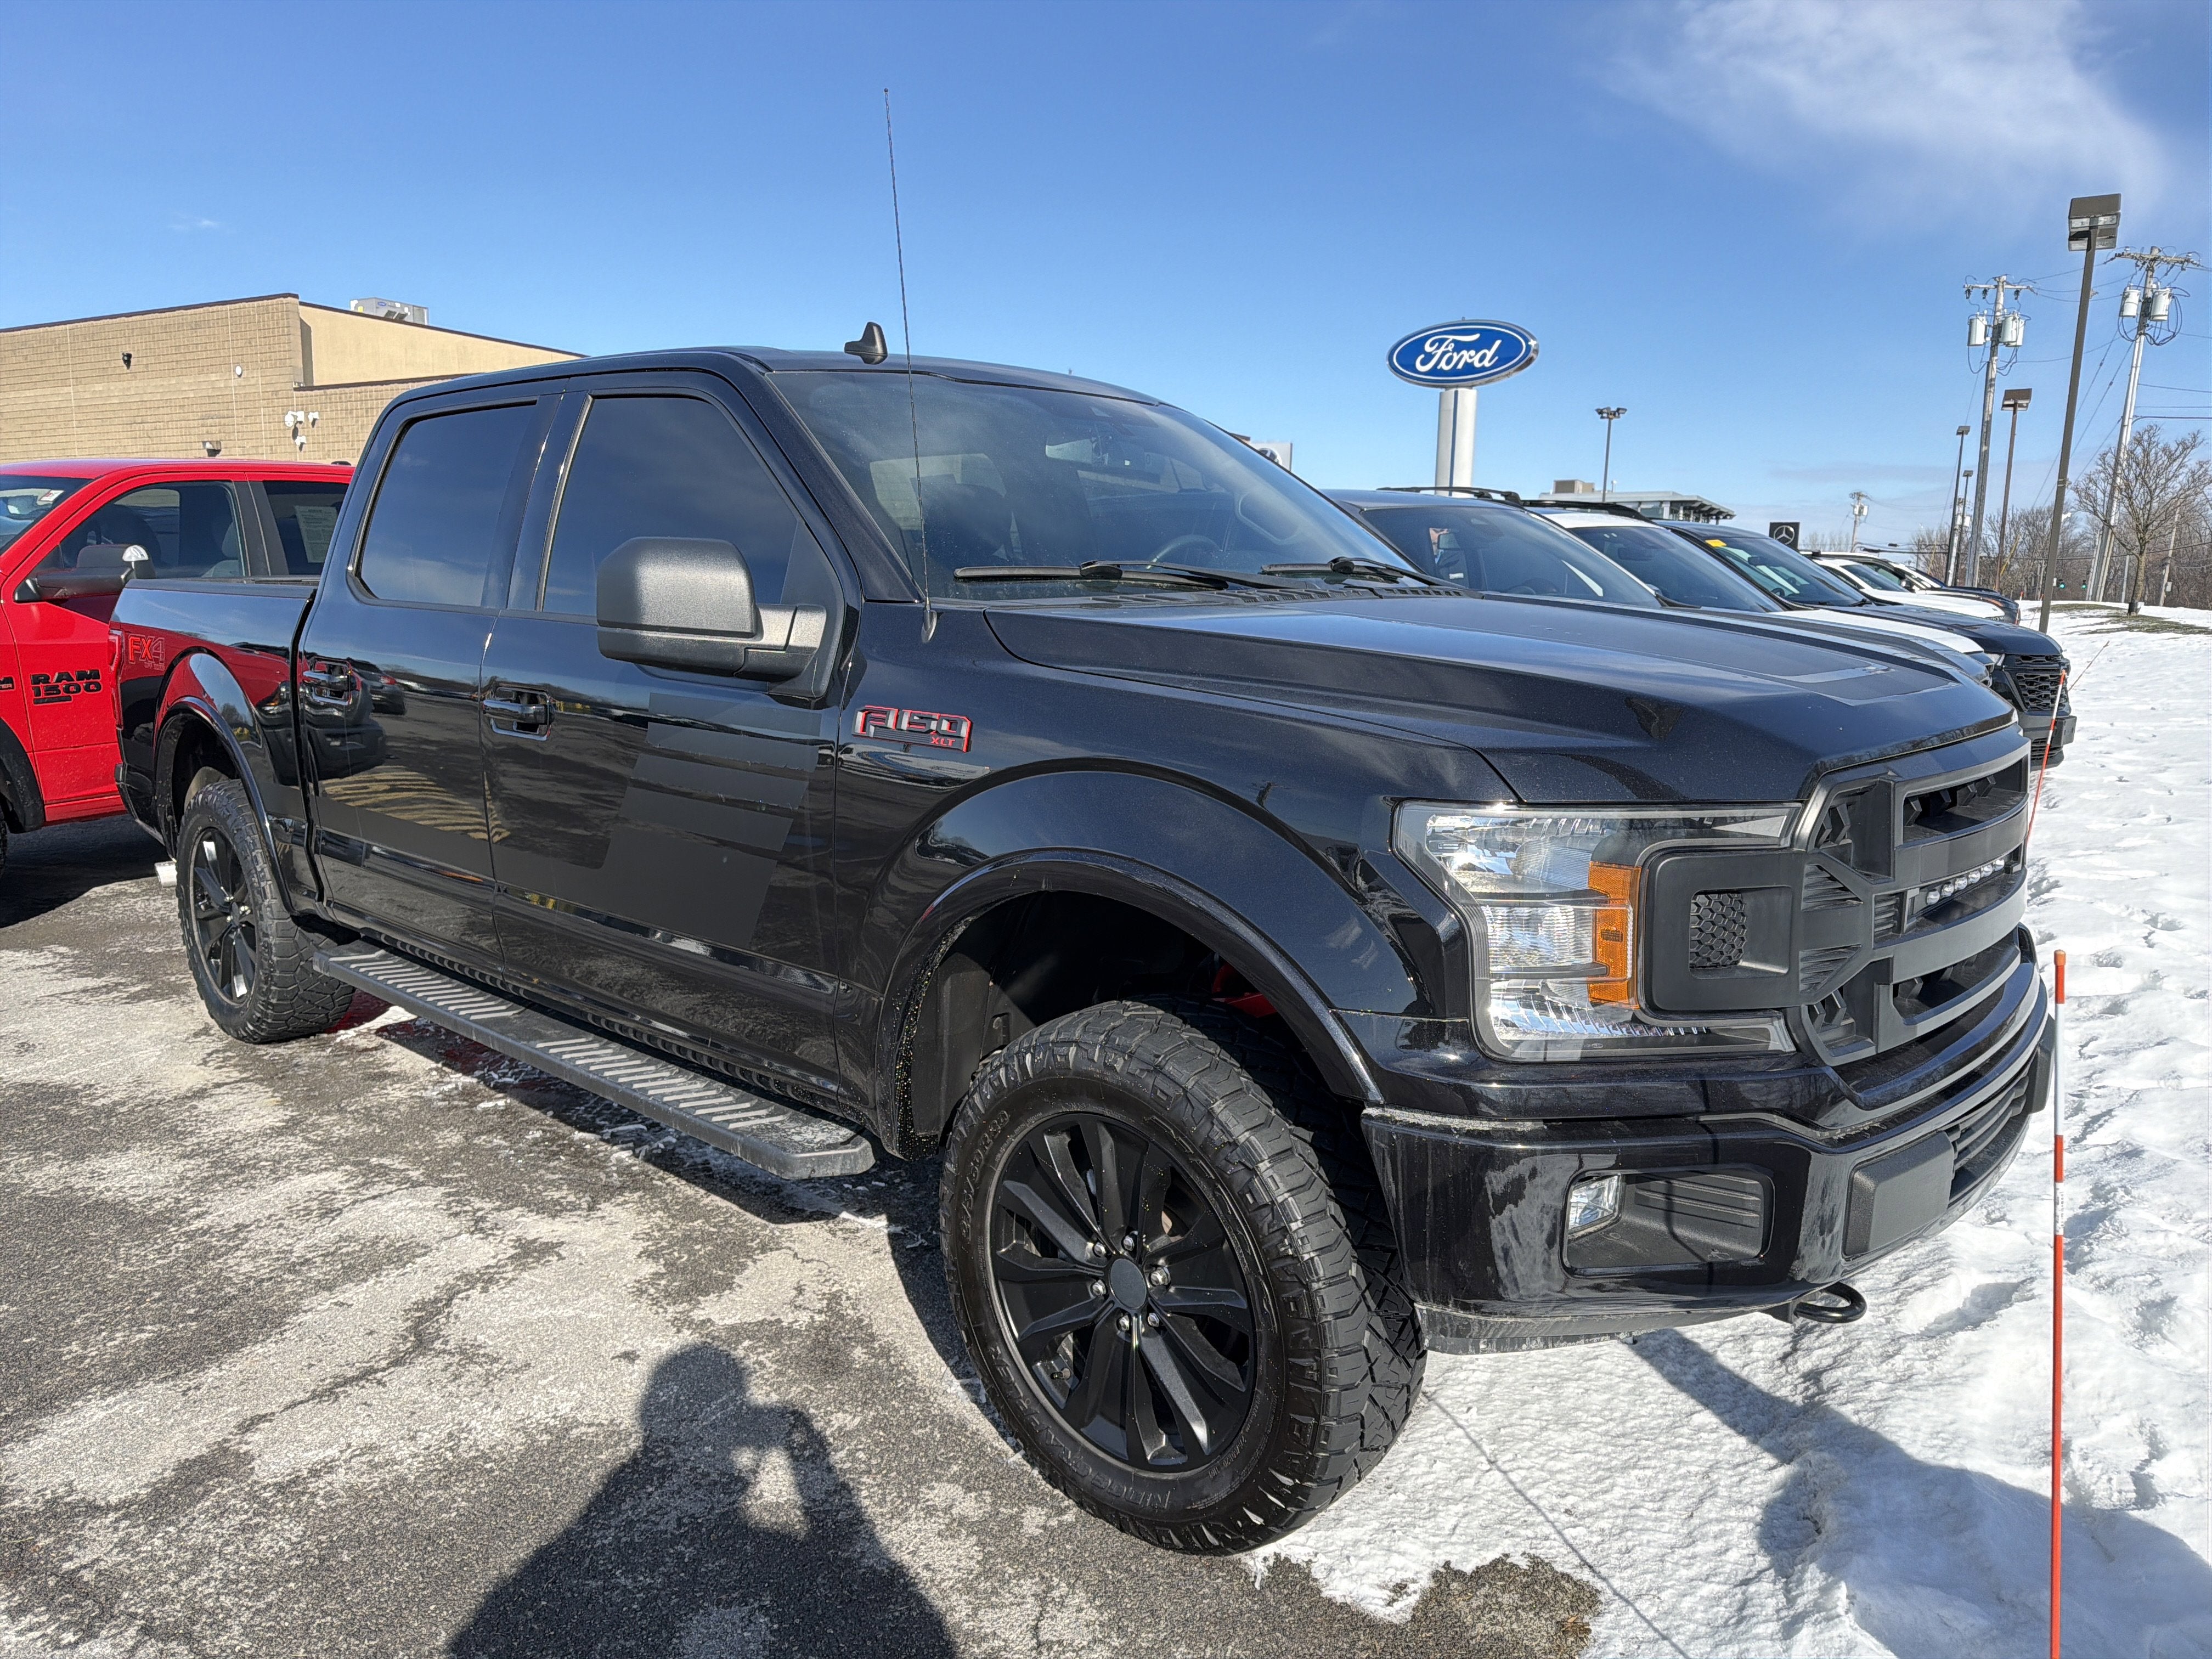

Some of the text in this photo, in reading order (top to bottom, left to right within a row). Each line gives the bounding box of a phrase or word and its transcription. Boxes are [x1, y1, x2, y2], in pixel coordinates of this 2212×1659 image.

[1415, 333, 1502, 373] Ford
[127, 633, 165, 665] FX4
[31, 669, 101, 686] RAM
[32, 681, 102, 698] 1500
[930, 736, 956, 747] XLT
